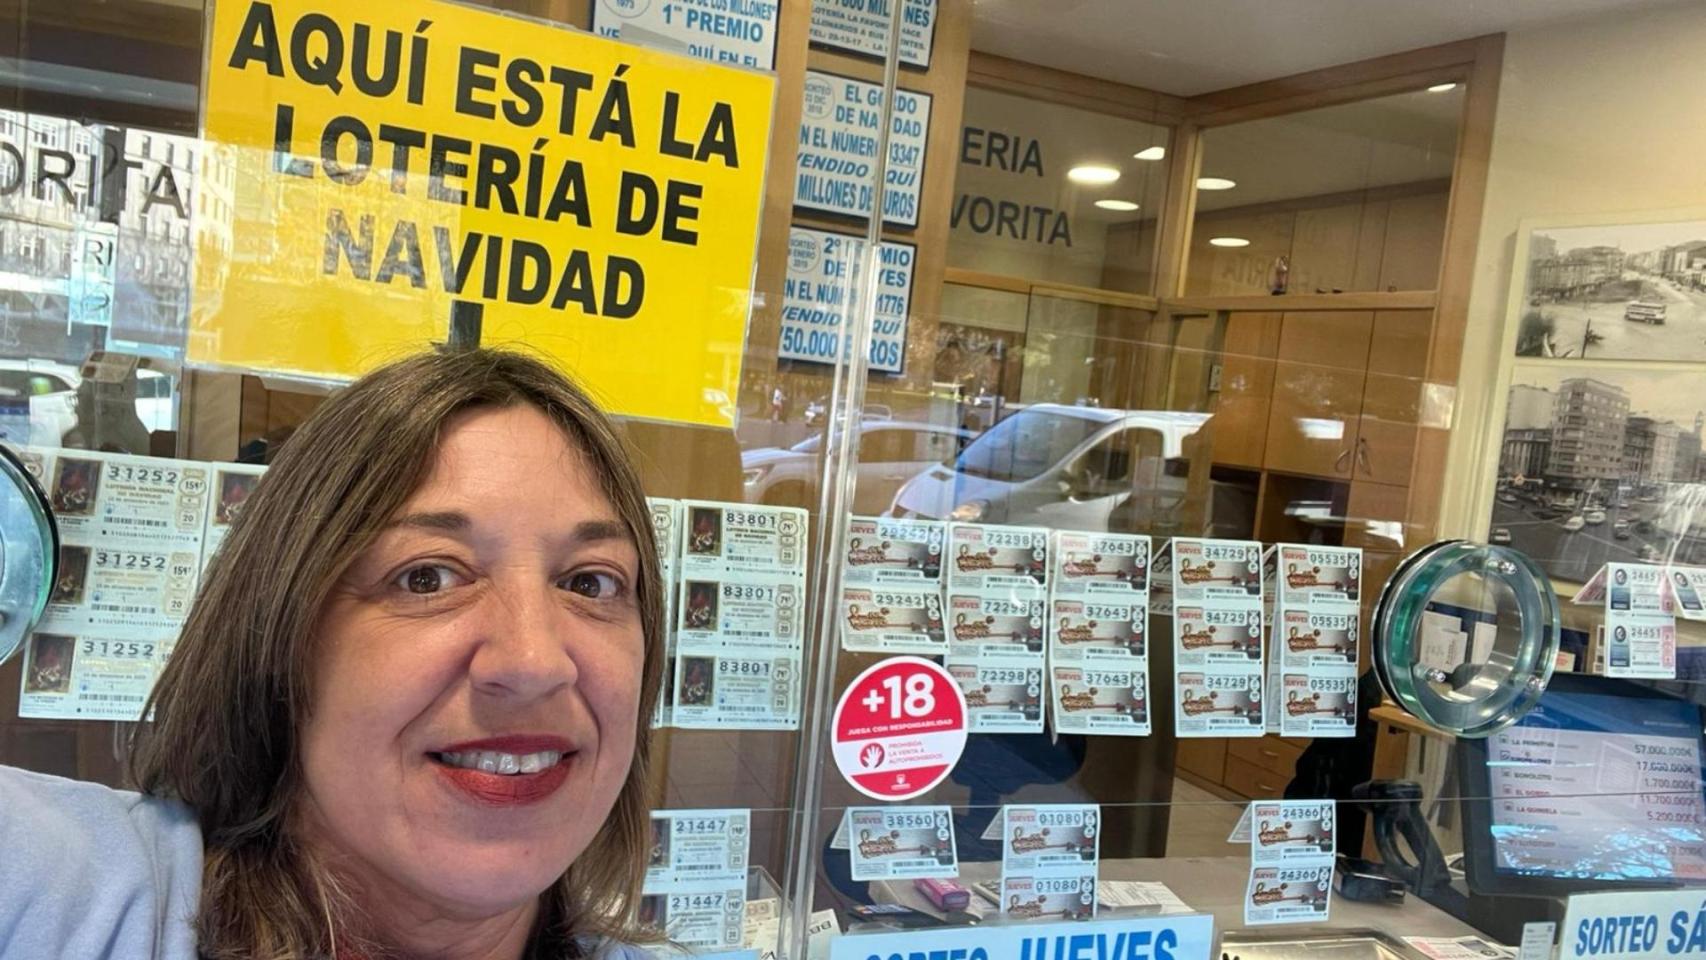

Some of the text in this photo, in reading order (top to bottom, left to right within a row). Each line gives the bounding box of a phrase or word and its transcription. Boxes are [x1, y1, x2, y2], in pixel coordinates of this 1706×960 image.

[686, 8, 763, 43] PREMIO
[688, 44, 714, 59] QUÍ
[228, 1, 739, 169] AQUÍ ESTÁ LA
[846, 84, 917, 114] EL GDO
[836, 105, 922, 138] DE NADAD
[813, 127, 828, 148] EL
[831, 127, 878, 158] NÚMER
[890, 142, 920, 166] 3347
[961, 127, 1044, 176] ERIA
[273, 105, 703, 246] LOTERÍA DE
[797, 174, 857, 209] MILLONES
[884, 189, 915, 219] UROS
[950, 194, 1073, 247] VORITA
[322, 208, 646, 320] NAVIDAD
[798, 281, 812, 301] EL
[873, 319, 902, 336] QUÍ
[108, 466, 177, 484] 31252
[727, 512, 775, 529] 83801
[987, 533, 1030, 545] 72298
[1205, 546, 1244, 559] 34729
[1310, 553, 1346, 565] 05535
[96, 552, 165, 569] 31252
[723, 586, 773, 602] 83801
[876, 594, 922, 606] 29242
[1086, 606, 1128, 618] 37643
[1206, 612, 1245, 624] 34729
[1311, 616, 1346, 628] 05535
[83, 641, 154, 657] 31252
[720, 661, 769, 675] 83801
[981, 670, 1025, 682] 72298
[1086, 673, 1129, 685] 37643
[1207, 676, 1246, 688] 34729
[1310, 679, 1346, 691] 05535
[862, 673, 935, 719] +18
[872, 725, 888, 733] CON
[889, 719, 953, 731] RESPONSABILIDAD
[676, 820, 726, 833] 21447
[887, 815, 932, 828] 38560
[1039, 813, 1081, 826] 01080
[1036, 880, 1078, 893] 01080
[672, 896, 723, 909] 21447
[1576, 915, 1659, 957] SORTEO
